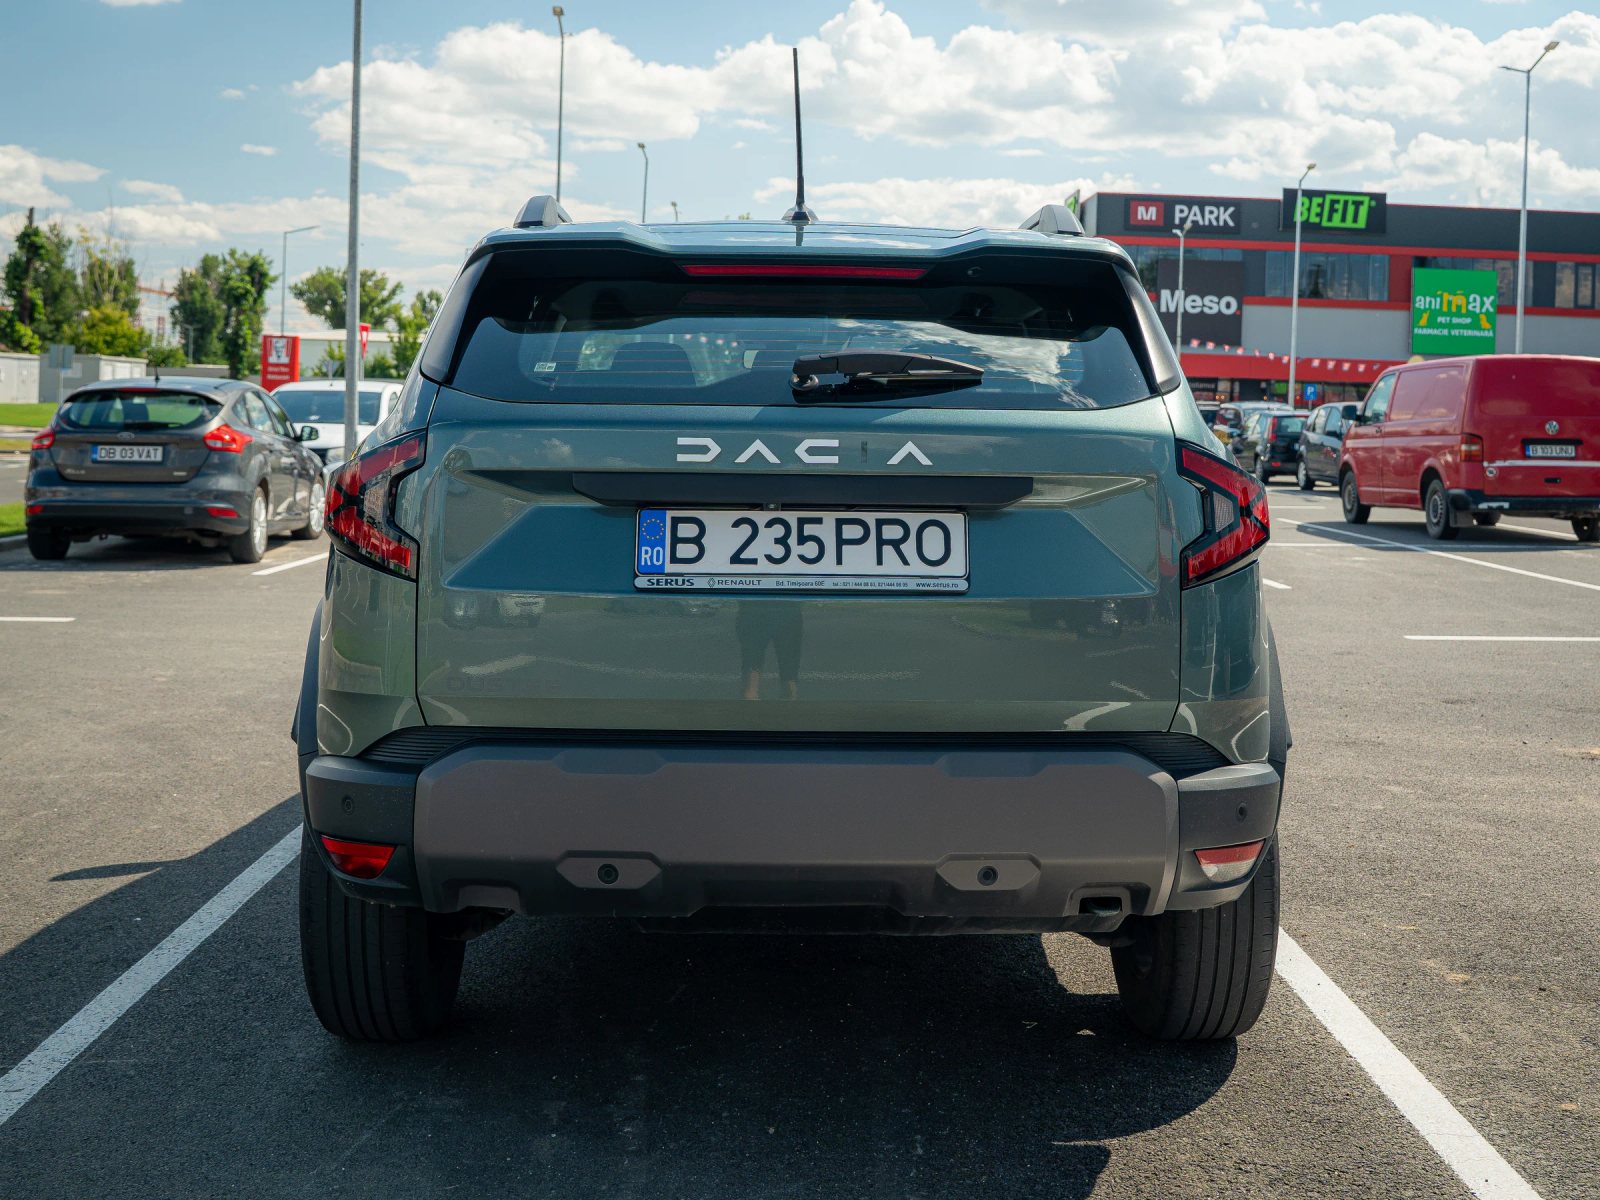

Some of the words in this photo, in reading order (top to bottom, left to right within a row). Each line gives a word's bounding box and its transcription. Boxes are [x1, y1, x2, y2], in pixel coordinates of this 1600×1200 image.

[1137, 205, 1157, 221] M
[1174, 204, 1236, 227] PARK
[1293, 194, 1370, 229] BEFIT
[1437, 316, 1450, 324] PET
[100, 447, 116, 459] DB
[120, 447, 135, 459] 03
[137, 448, 160, 459] VAT
[677, 437, 934, 466] DACIA
[1531, 446, 1538, 455] B
[669, 516, 706, 565] B
[640, 546, 663, 566] RO
[646, 578, 695, 587] SERUS
[717, 579, 763, 587] RENAULT
